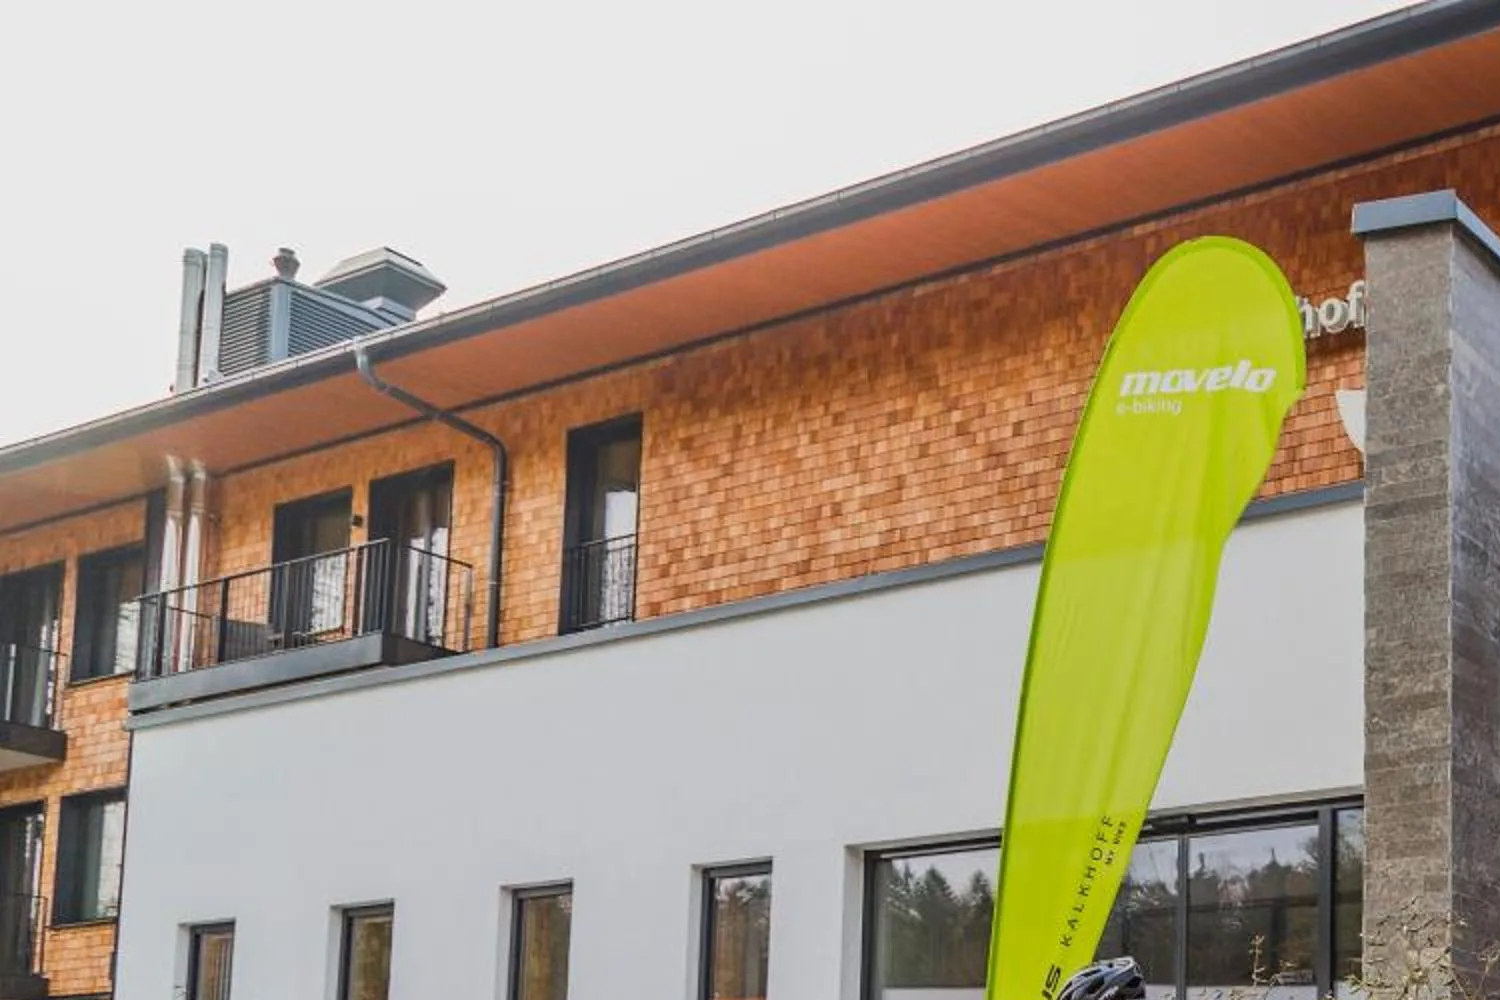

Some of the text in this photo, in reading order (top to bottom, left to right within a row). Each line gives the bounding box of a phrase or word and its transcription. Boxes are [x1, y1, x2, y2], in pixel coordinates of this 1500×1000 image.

[1119, 358, 1277, 397] movelo
[1116, 398, 1182, 416] e-biking
[1060, 815, 1113, 947] KALKHOFF
